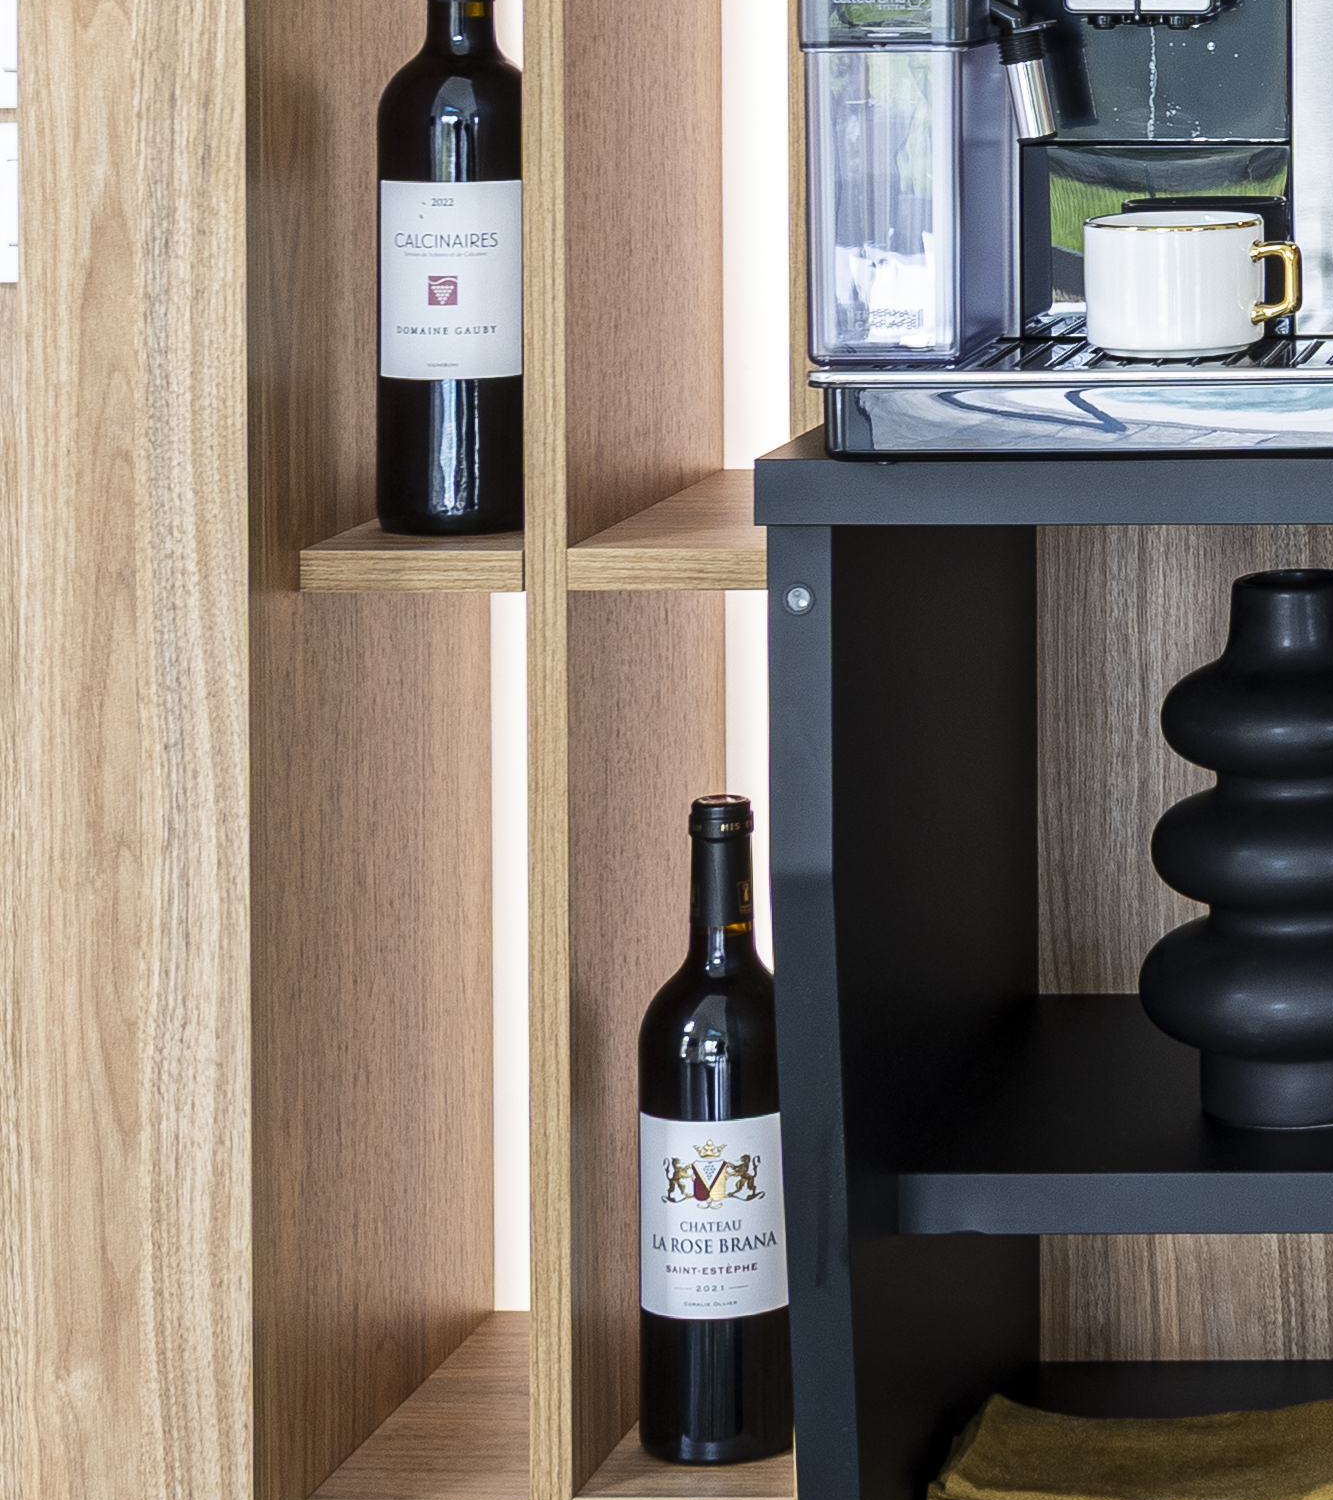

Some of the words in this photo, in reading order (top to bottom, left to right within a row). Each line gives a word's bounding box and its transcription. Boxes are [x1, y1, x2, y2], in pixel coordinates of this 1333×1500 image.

[431, 197, 455, 207] 2022
[395, 232, 499, 249] CALCINAIRES
[397, 325, 449, 336] DOMAINE
[454, 324, 498, 336] GAUBY
[679, 1218, 742, 1233] CHATEAU
[652, 1233, 668, 1252] LA
[670, 1237, 714, 1255] ROSE
[719, 1230, 778, 1255] BRANA
[665, 1262, 759, 1276] SAINT-ESTÈPHE
[695, 1284, 725, 1293] 2021
